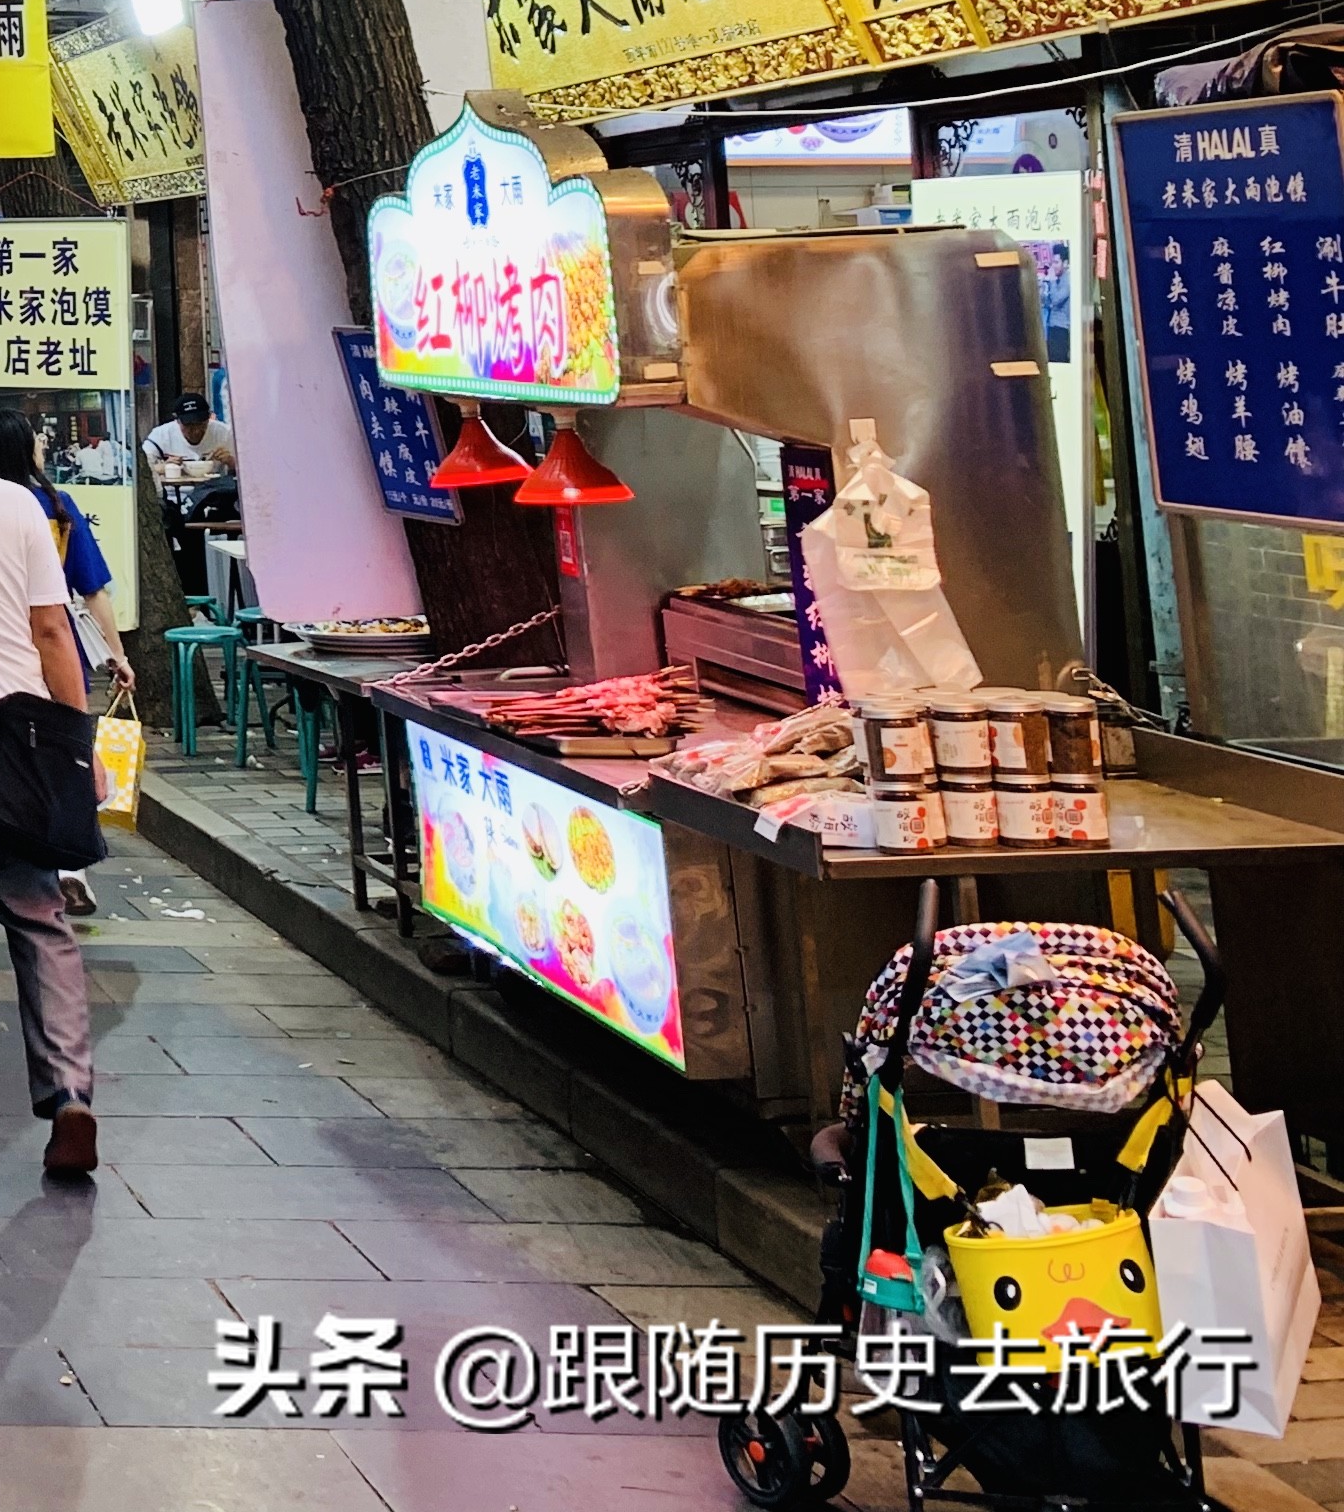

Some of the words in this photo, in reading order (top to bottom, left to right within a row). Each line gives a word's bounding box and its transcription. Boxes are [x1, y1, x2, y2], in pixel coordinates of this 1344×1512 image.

[1173, 133, 1193, 163] 清
[1197, 125, 1255, 161] HALAL
[1258, 123, 1280, 157] 真
[1161, 170, 1308, 210] 老米家大雨泡馍
[415, 256, 564, 374] 红柳烤肉
